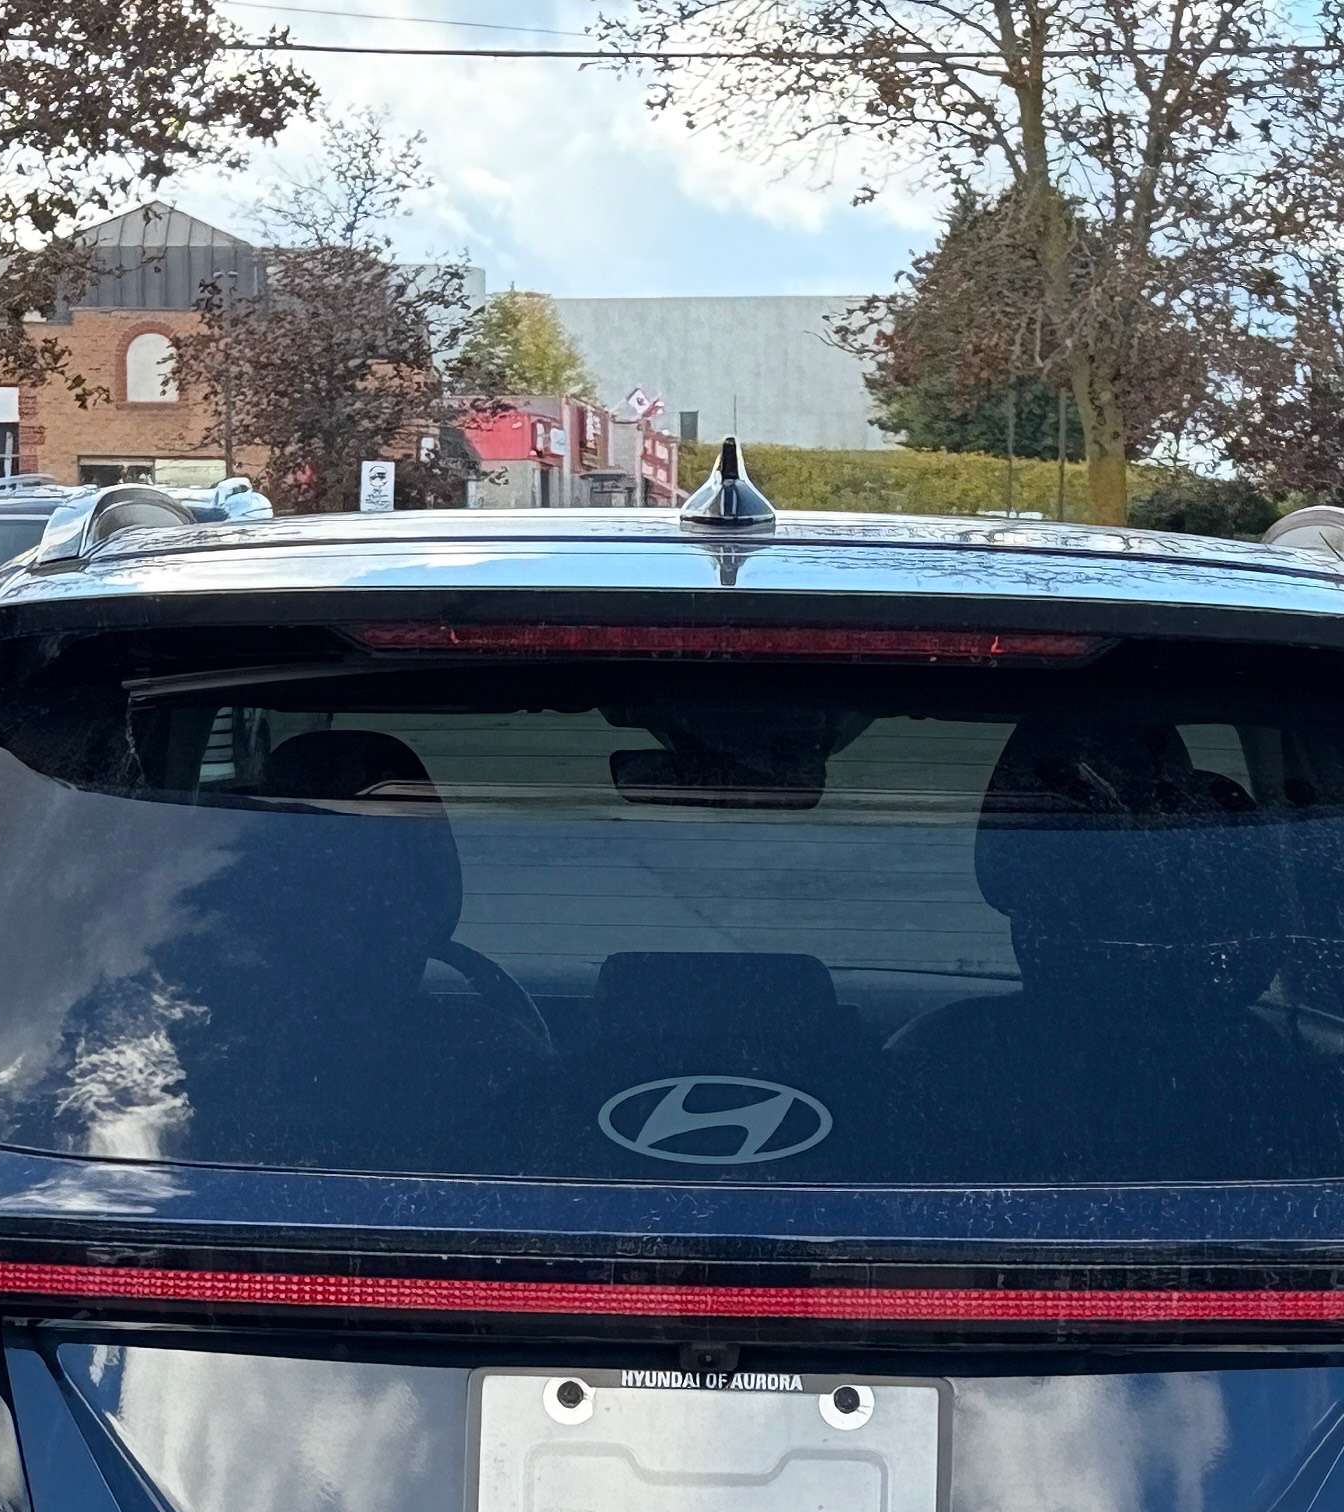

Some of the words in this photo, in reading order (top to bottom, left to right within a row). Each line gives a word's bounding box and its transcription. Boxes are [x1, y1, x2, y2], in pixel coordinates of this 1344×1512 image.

[621, 1370, 701, 1388] HYUNDAI
[706, 1372, 728, 1389] OF
[731, 1373, 803, 1391] AURORA
